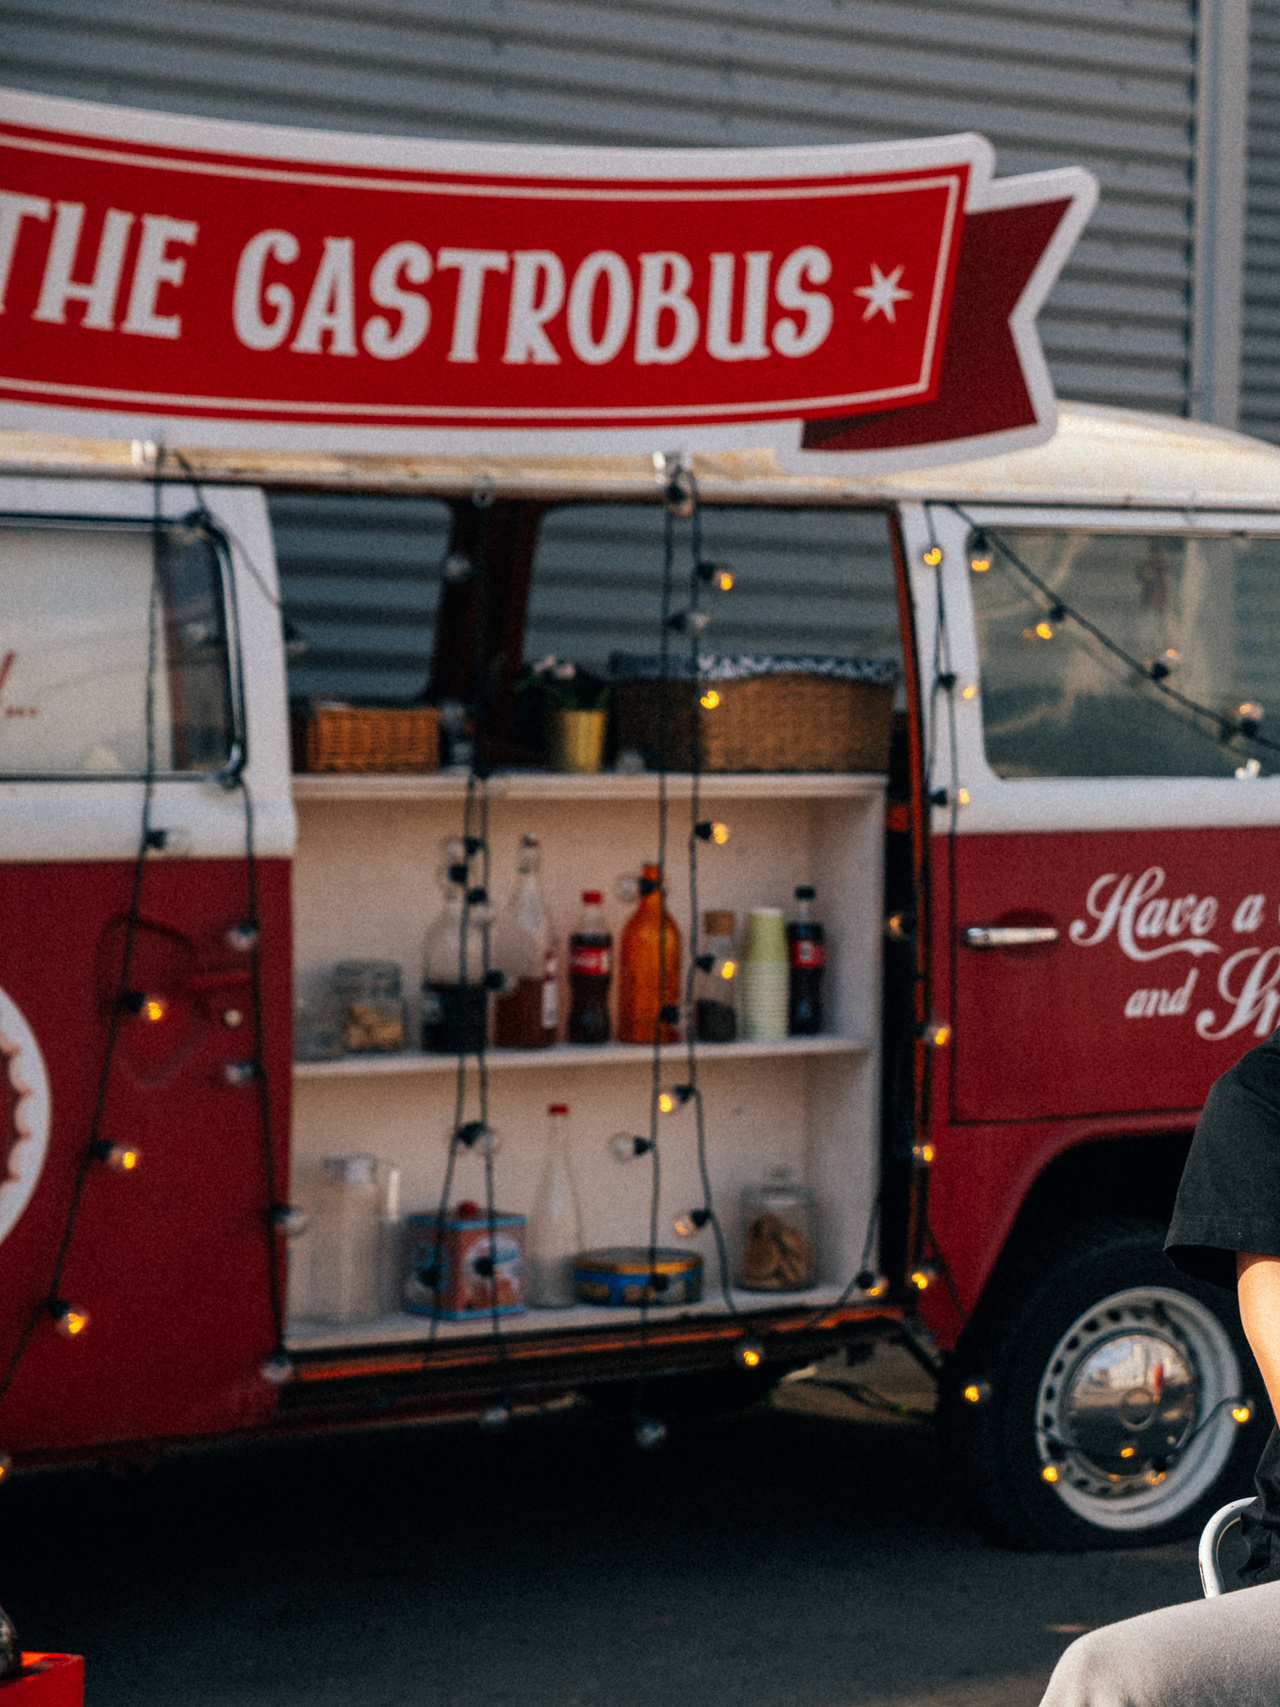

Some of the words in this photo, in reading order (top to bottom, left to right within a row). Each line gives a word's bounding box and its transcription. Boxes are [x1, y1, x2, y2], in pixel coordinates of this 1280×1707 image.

[0, 190, 198, 340] THE
[232, 228, 834, 366] GASTROBUS
[1069, 866, 1221, 962] Have
[1231, 894, 1266, 933] a
[1123, 967, 1198, 1018] and
